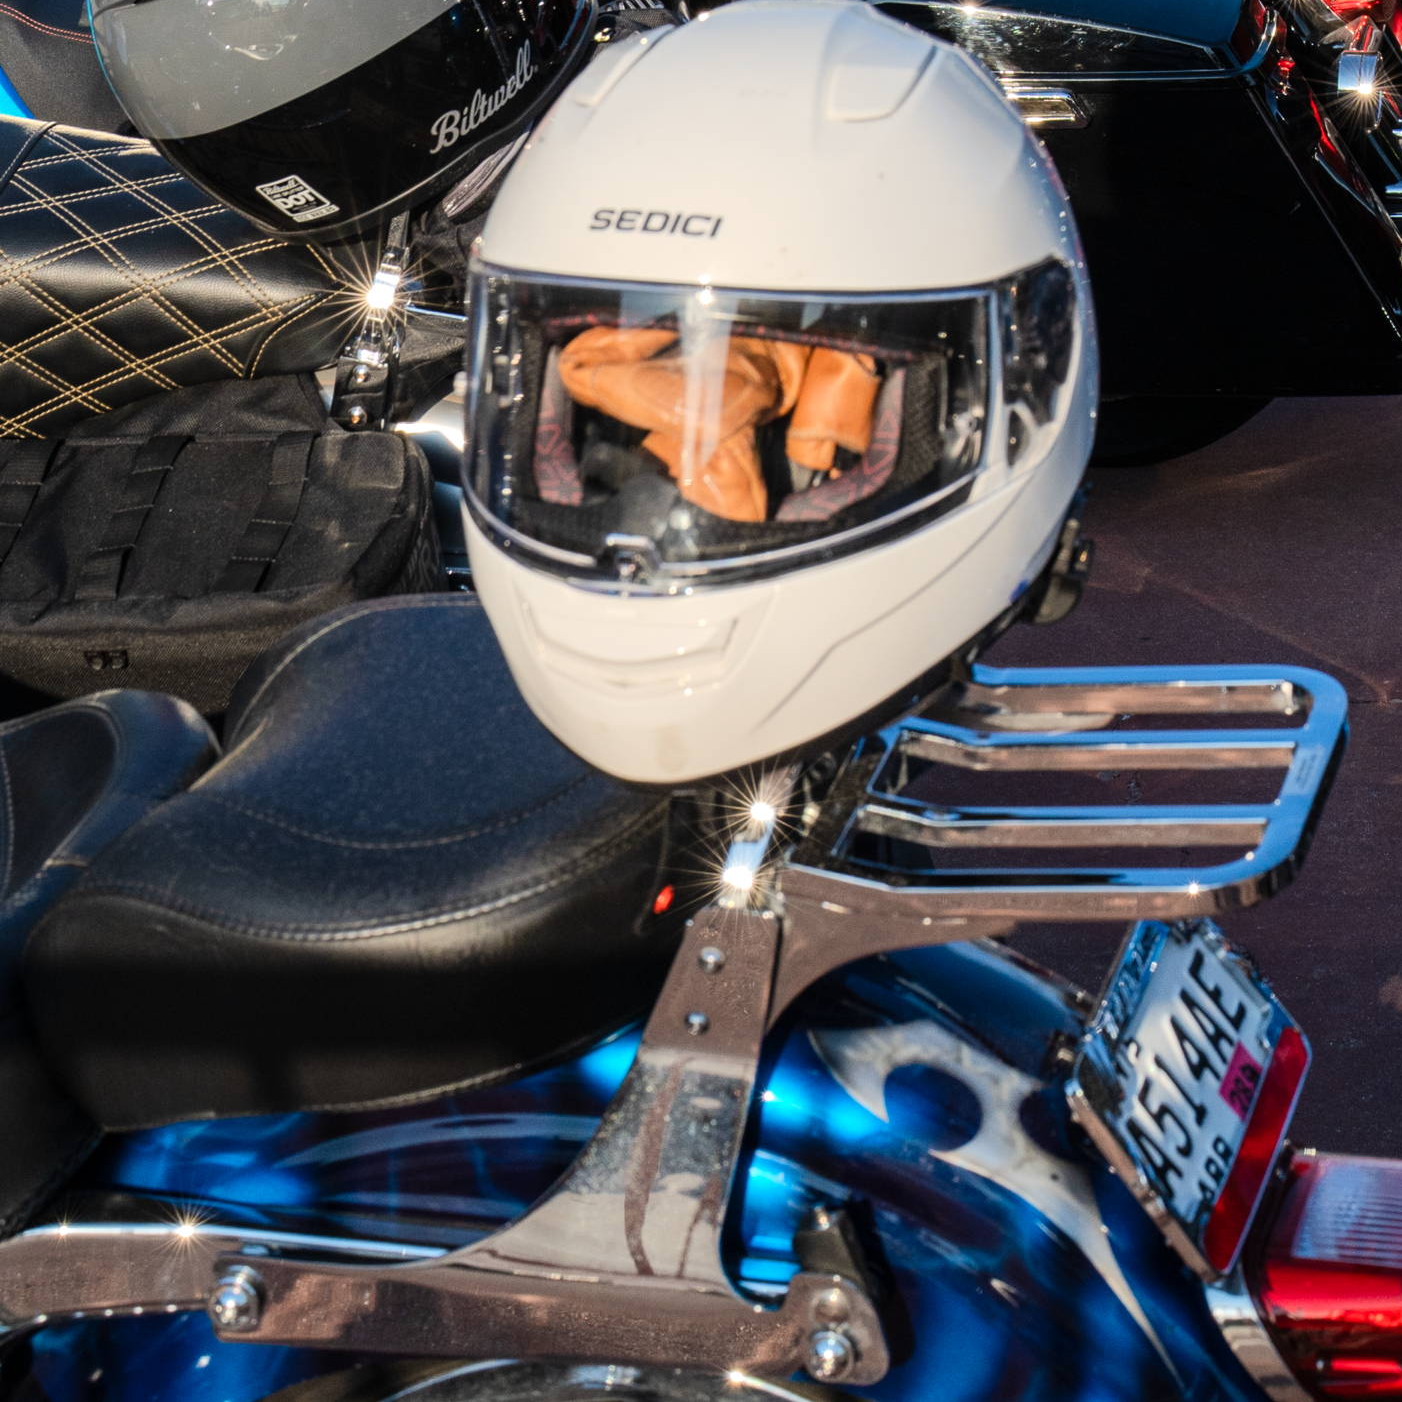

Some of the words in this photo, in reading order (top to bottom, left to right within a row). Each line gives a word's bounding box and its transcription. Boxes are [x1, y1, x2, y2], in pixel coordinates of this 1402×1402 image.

[429, 38, 534, 154] Biltwell
[274, 190, 315, 210] DOT
[589, 209, 722, 237] SEDICI
